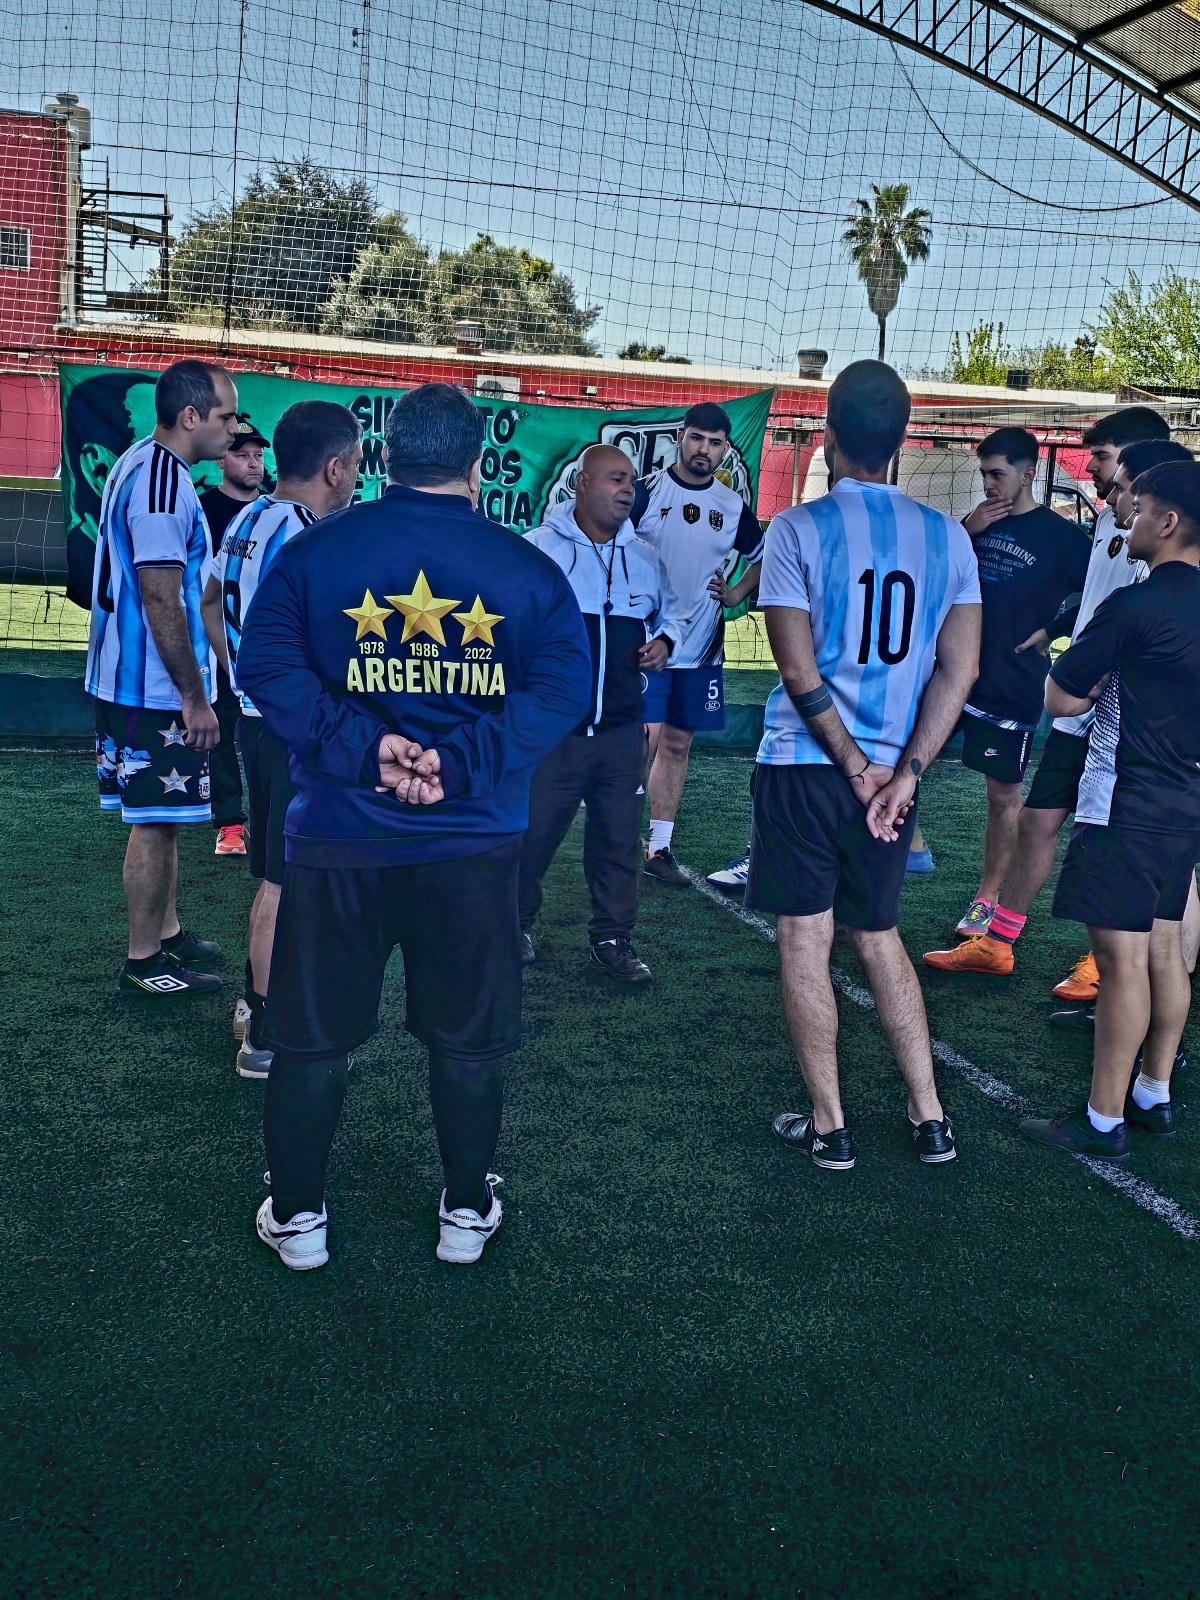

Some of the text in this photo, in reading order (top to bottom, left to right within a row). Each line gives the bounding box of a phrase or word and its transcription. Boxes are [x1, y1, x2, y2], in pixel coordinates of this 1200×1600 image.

[973, 537, 1037, 566] OWBOARDING
[857, 568, 915, 665] 10
[359, 641, 492, 660] 1978 1986 2022
[347, 657, 506, 696] ARGENTINA
[707, 679, 719, 699] 5
